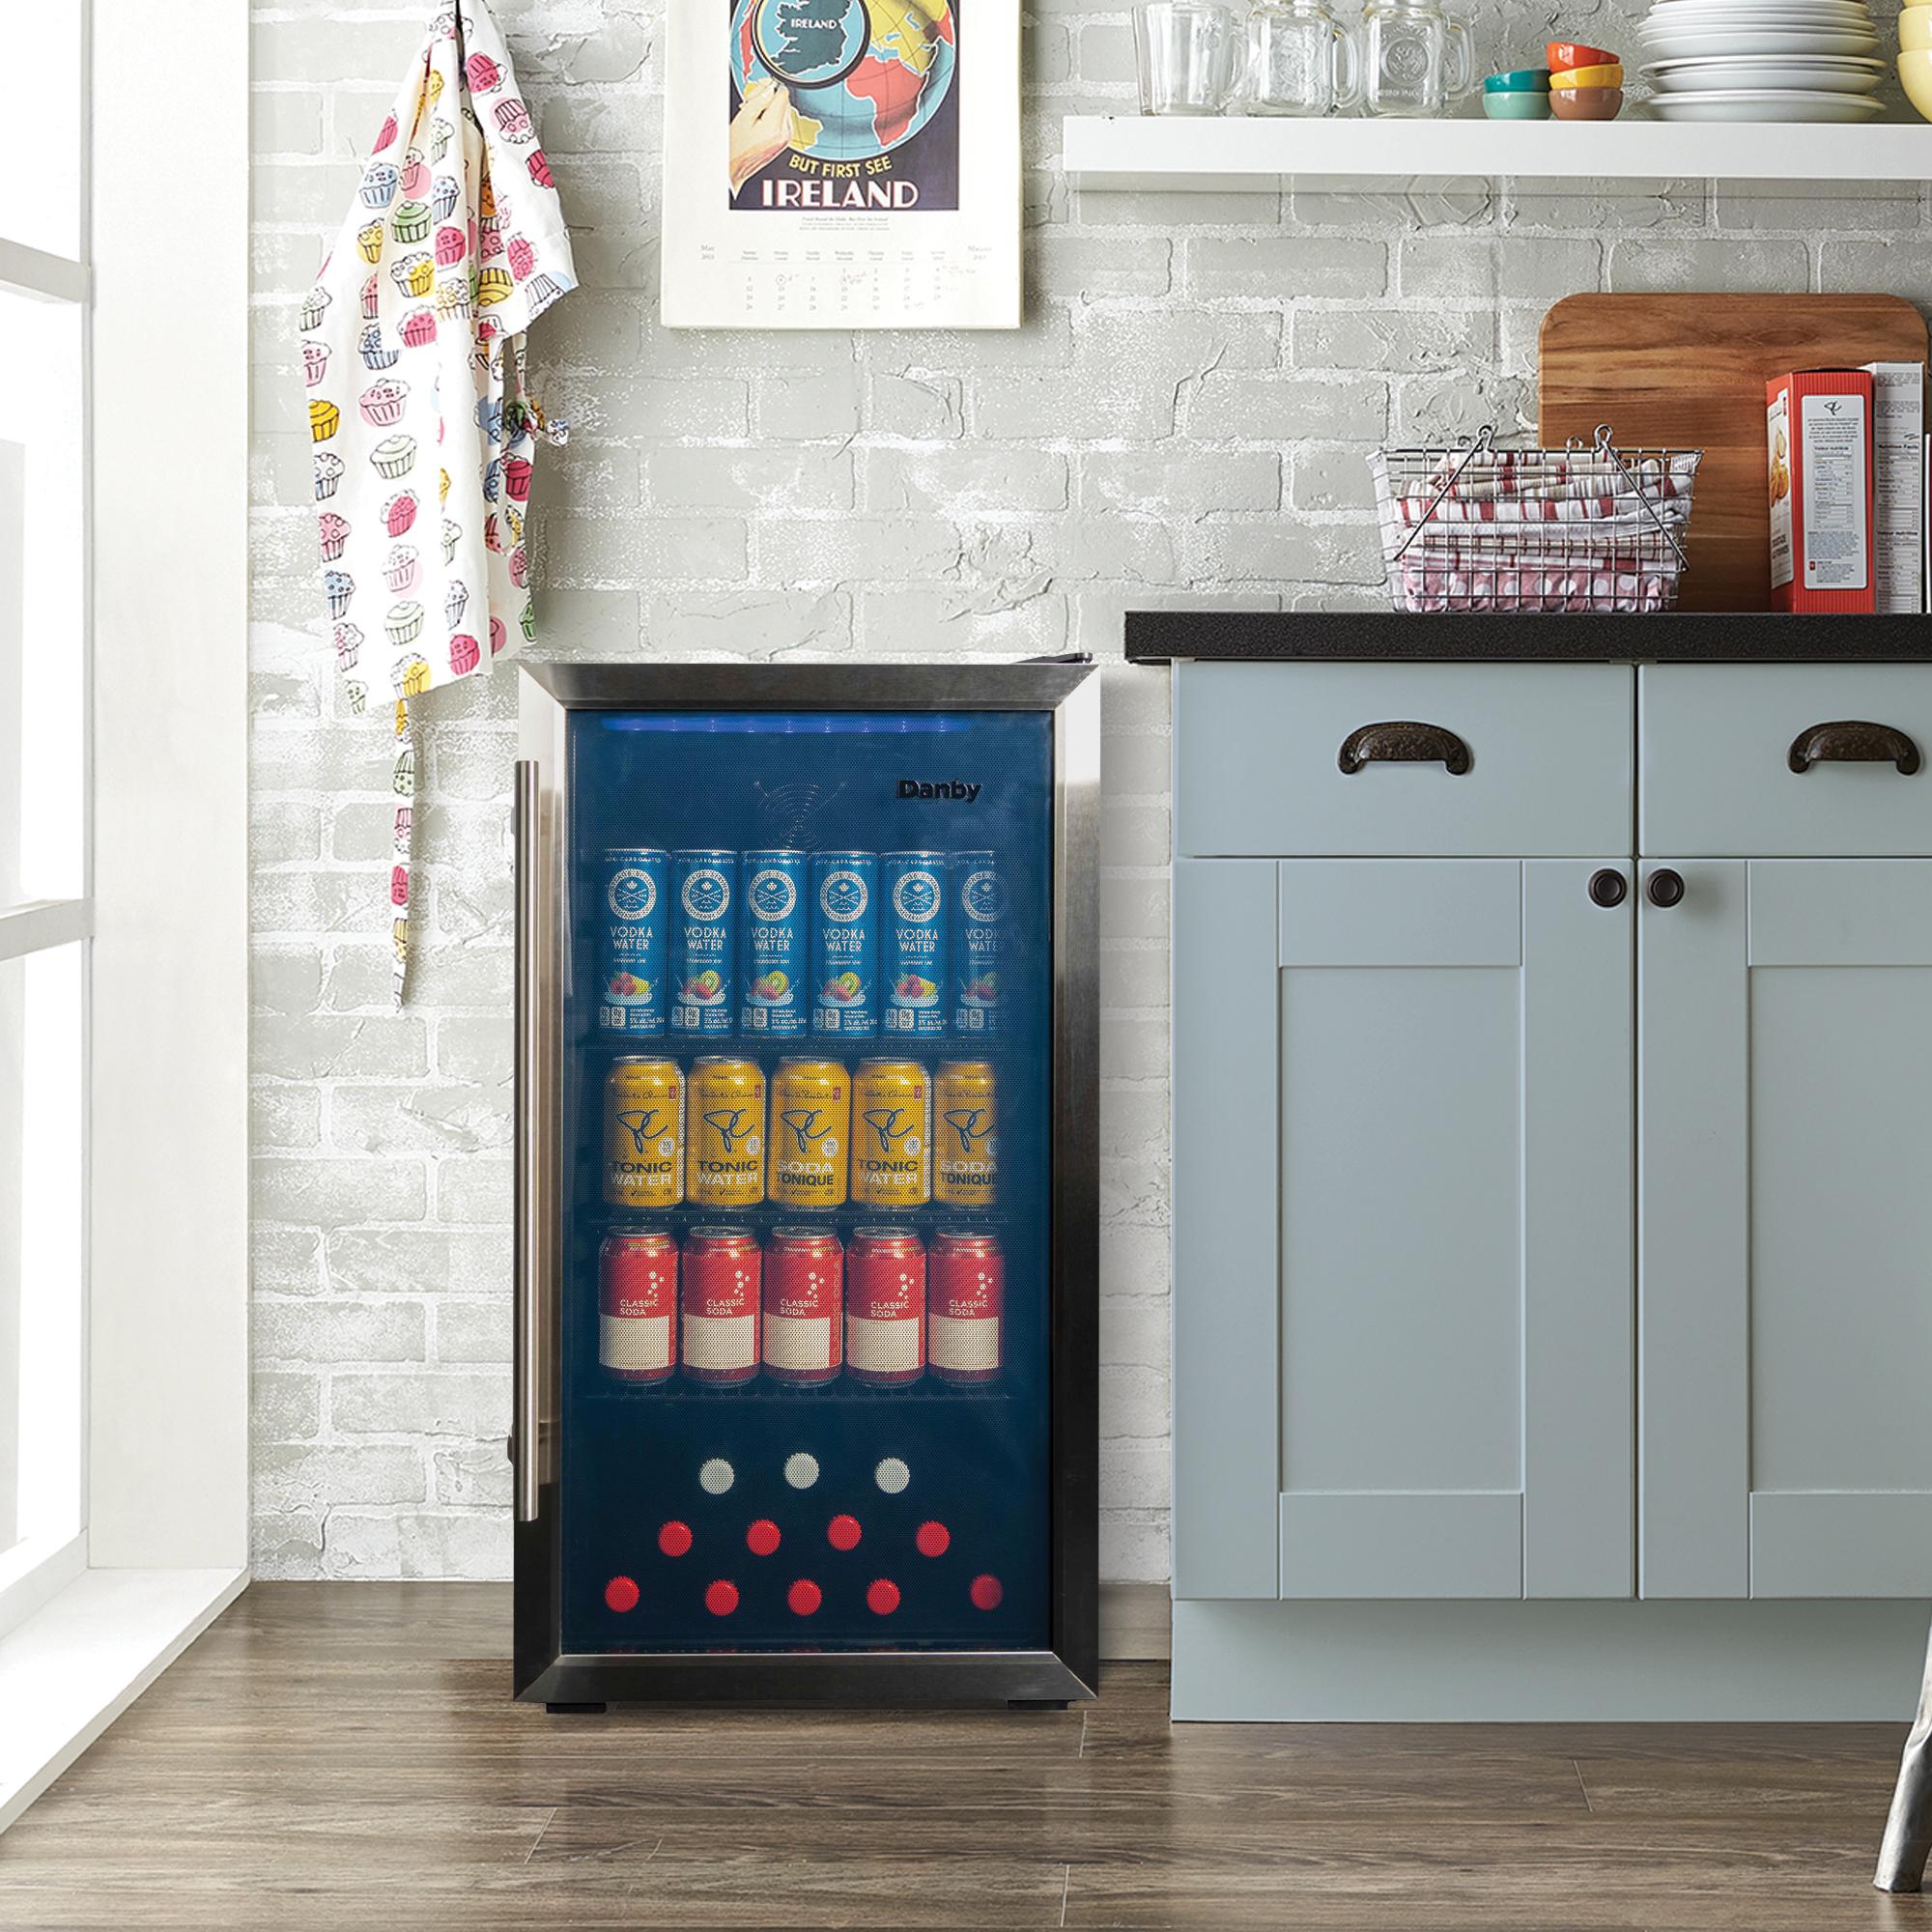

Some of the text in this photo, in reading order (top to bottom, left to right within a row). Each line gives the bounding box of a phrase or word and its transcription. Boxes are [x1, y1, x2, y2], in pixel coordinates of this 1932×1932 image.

[791, 18, 838, 29] IRELAND
[788, 155, 893, 178] BUT FIRST SEE
[761, 180, 919, 209] IRELAND
[896, 779, 981, 804] Danby
[610, 925, 653, 938] VODKA
[684, 926, 726, 939] VODKA
[751, 927, 794, 939] VODKA
[822, 928, 866, 940] VODKA
[895, 928, 939, 941] VODKA
[612, 938, 649, 951] WATER
[687, 939, 724, 951] WATER
[753, 940, 790, 952] WATER
[825, 940, 863, 952] WATER
[898, 941, 935, 952] WATER
[611, 1161, 672, 1174] TONIC
[698, 1160, 757, 1174] TONIC
[777, 1161, 834, 1174] SODA
[858, 1159, 918, 1172] TONIC
[940, 1161, 997, 1173] SODA
[610, 1174, 672, 1186] WATER
[697, 1174, 757, 1186] WATER
[777, 1174, 834, 1186] TONIQUE
[619, 1298, 659, 1308] CLASSIC
[706, 1297, 745, 1308] CLASSIC
[780, 1298, 819, 1308] CLASSIC
[870, 1300, 910, 1309] CLASSIC
[949, 1298, 988, 1308] CLASSIC
[619, 1307, 646, 1316] SODA
[706, 1307, 733, 1316] SODA
[780, 1307, 806, 1316] SODA
[870, 1309, 896, 1318] SODA
[949, 1308, 976, 1317] SODA
